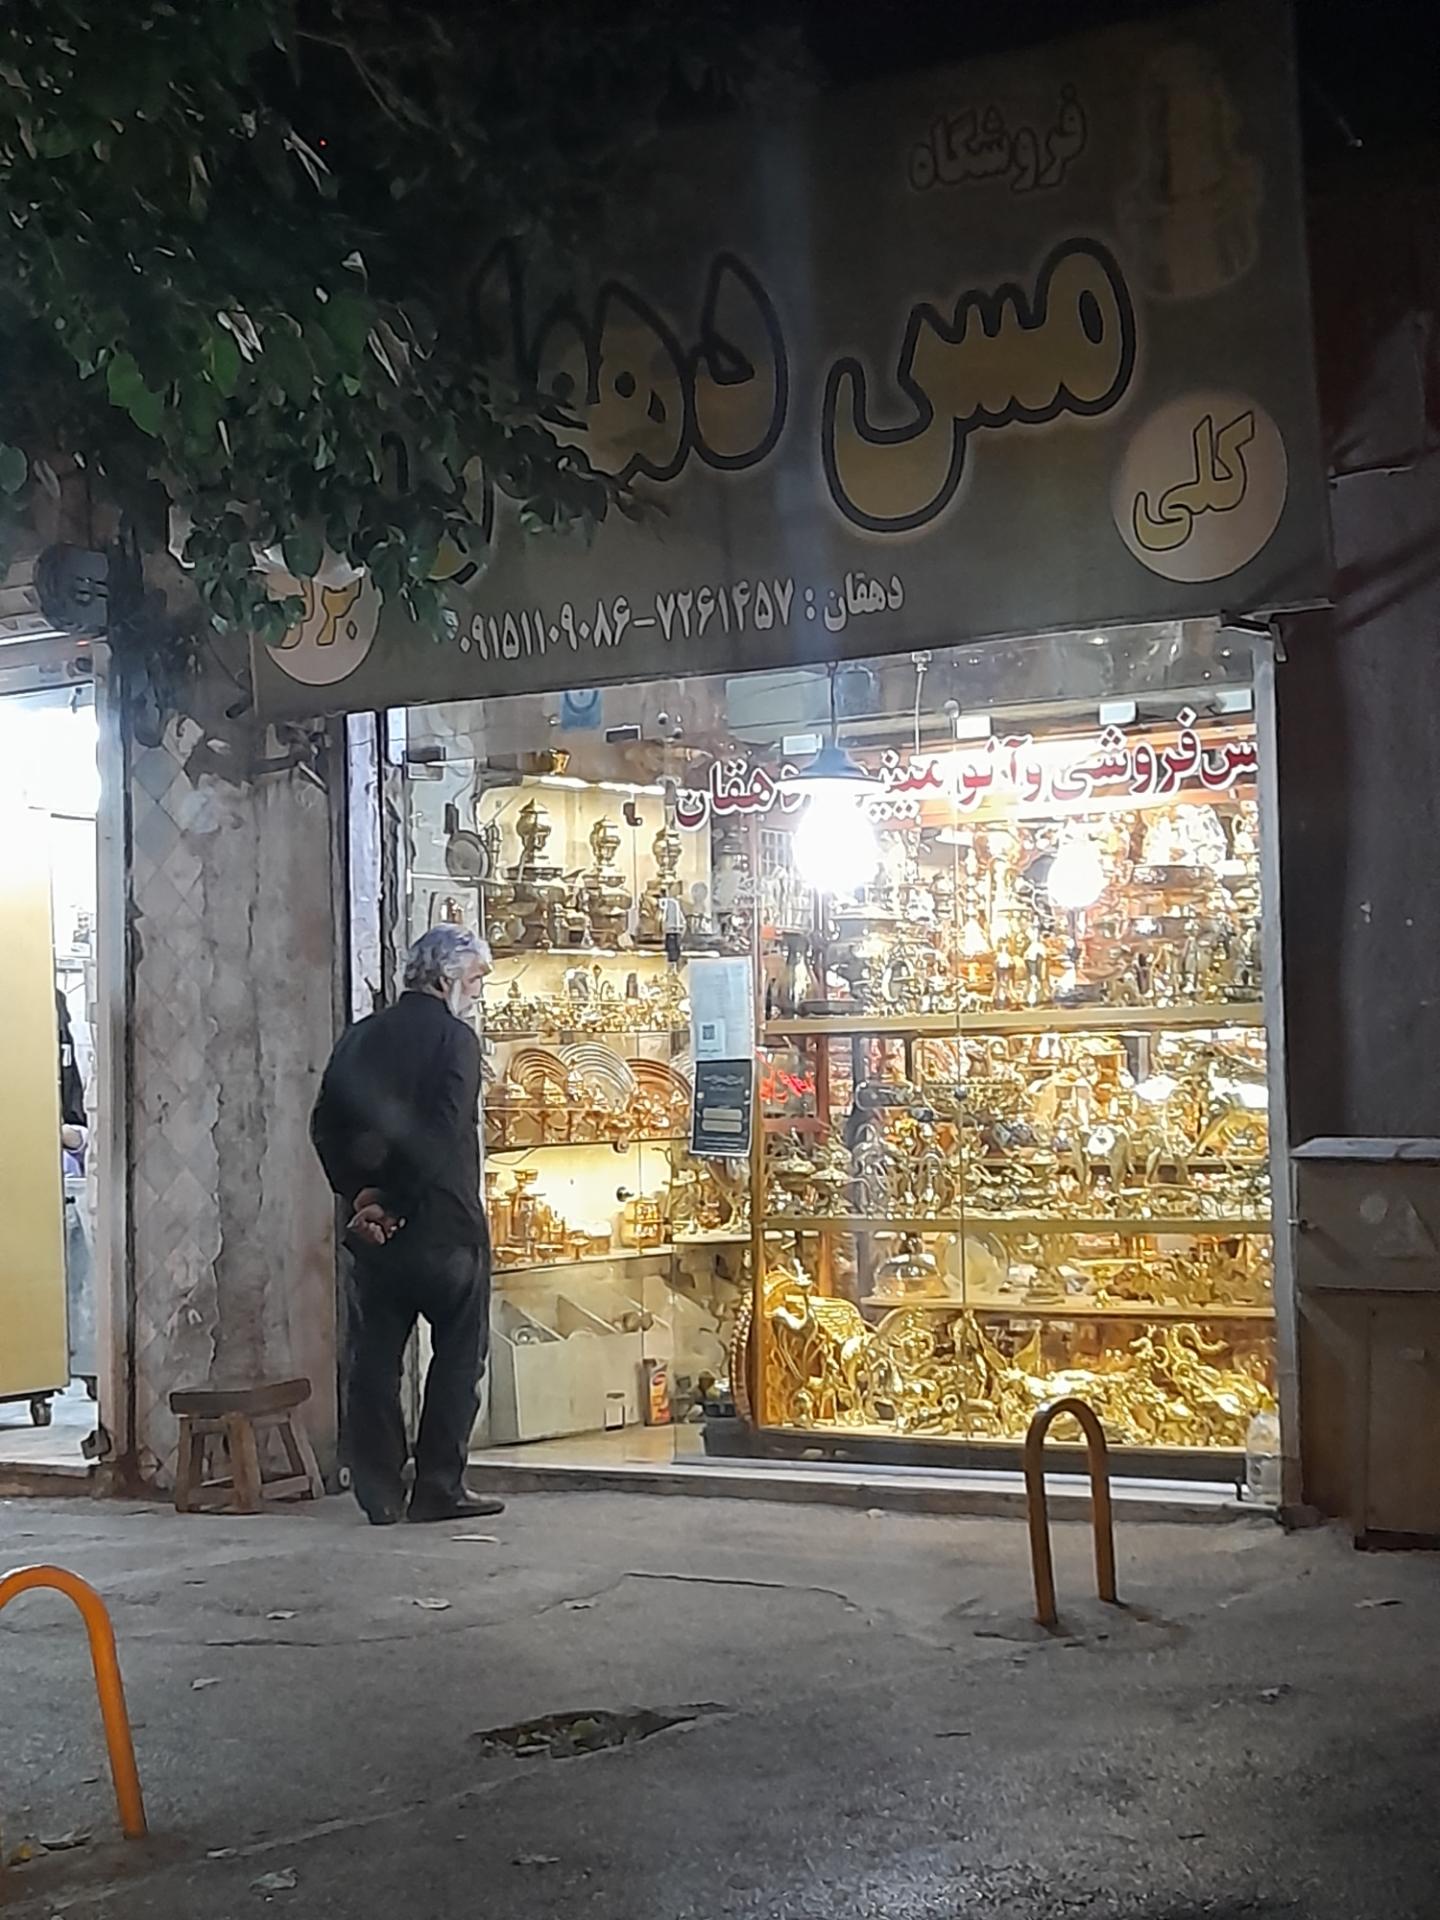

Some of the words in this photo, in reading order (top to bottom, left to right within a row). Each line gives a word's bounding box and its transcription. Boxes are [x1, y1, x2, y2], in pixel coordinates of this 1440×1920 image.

[910, 82, 1088, 193] فروشگاه
[1132, 411, 1255, 552] کلی
[1052, 706, 1202, 802] فروشی
